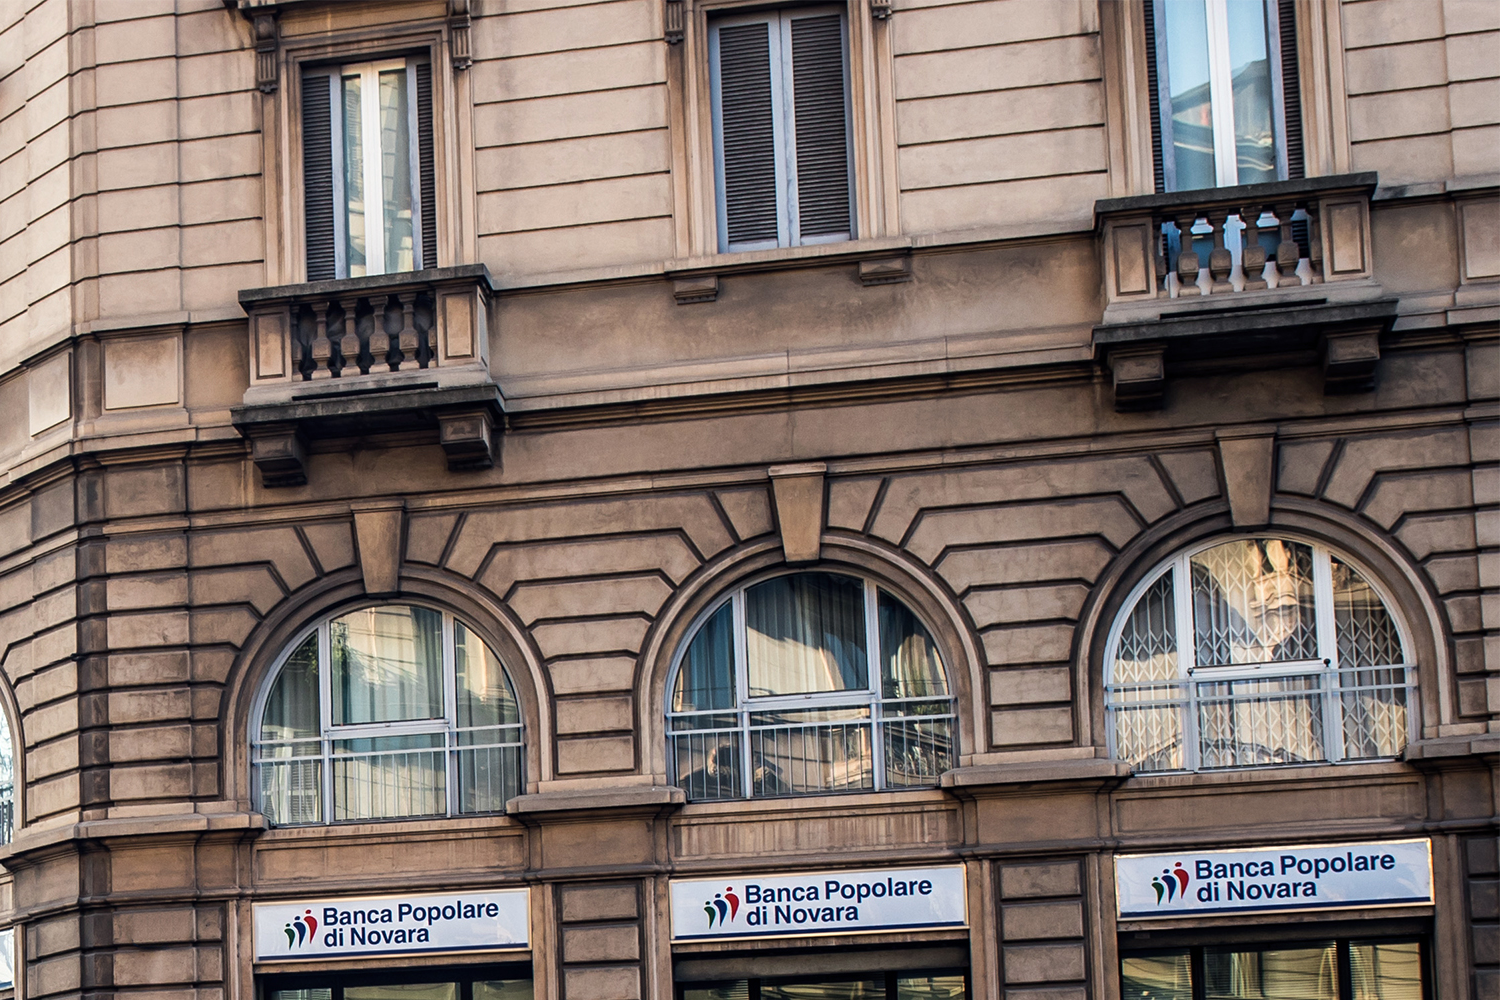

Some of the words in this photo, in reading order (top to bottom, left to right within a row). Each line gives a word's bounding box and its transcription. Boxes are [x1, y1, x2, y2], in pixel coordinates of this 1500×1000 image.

[1195, 859, 1275, 880] Banca
[1280, 851, 1396, 879] Popolare
[744, 884, 820, 904] Banca
[824, 877, 933, 904] Popolare
[1196, 882, 1220, 903] di
[1227, 879, 1317, 901] Novara
[322, 906, 393, 926] Banca
[398, 900, 499, 925] Popolare
[746, 906, 767, 926] di
[775, 904, 859, 925] Novara
[323, 929, 344, 948] di
[350, 926, 430, 946] Novara
